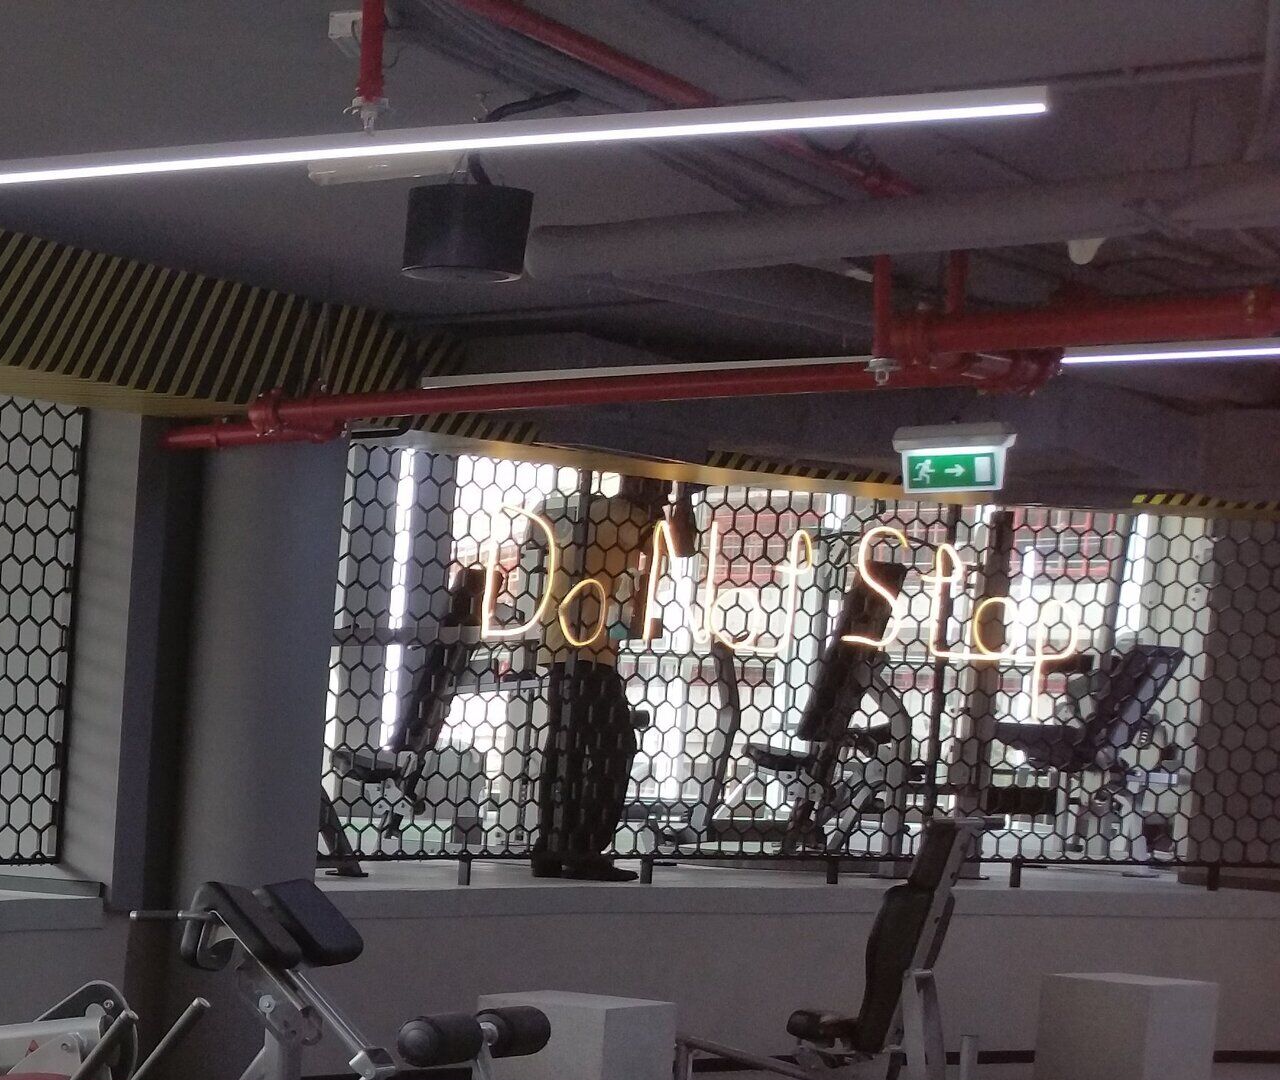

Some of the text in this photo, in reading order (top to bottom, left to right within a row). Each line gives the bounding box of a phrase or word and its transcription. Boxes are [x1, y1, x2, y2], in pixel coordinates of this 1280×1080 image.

[481, 505, 1079, 721] Do Not Stop
